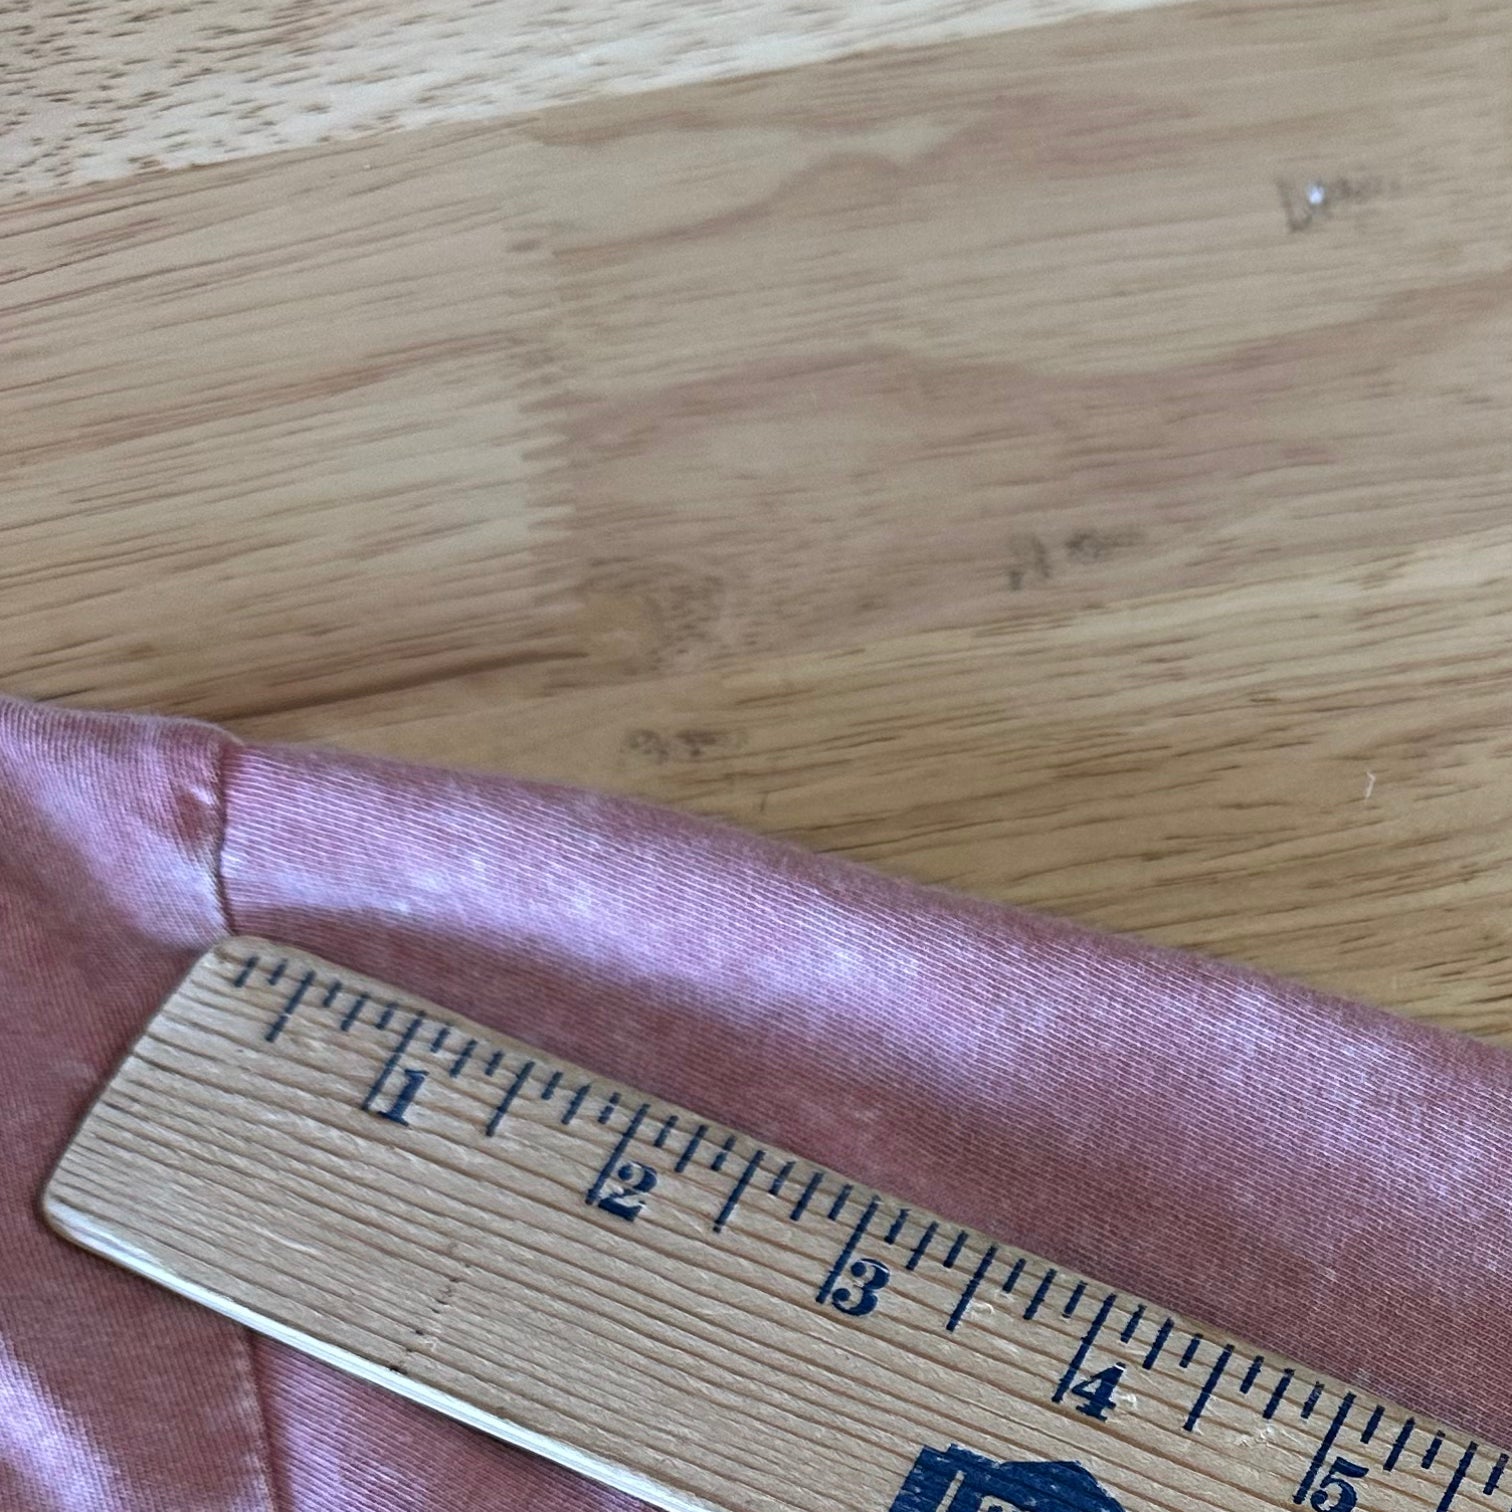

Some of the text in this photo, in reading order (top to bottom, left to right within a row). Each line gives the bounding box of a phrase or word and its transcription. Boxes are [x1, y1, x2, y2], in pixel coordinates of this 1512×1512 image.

[377, 1069, 428, 1127] 1
[600, 1161, 658, 1222] 2
[831, 1258, 891, 1317] 3
[1072, 1362, 1127, 1421] 4
